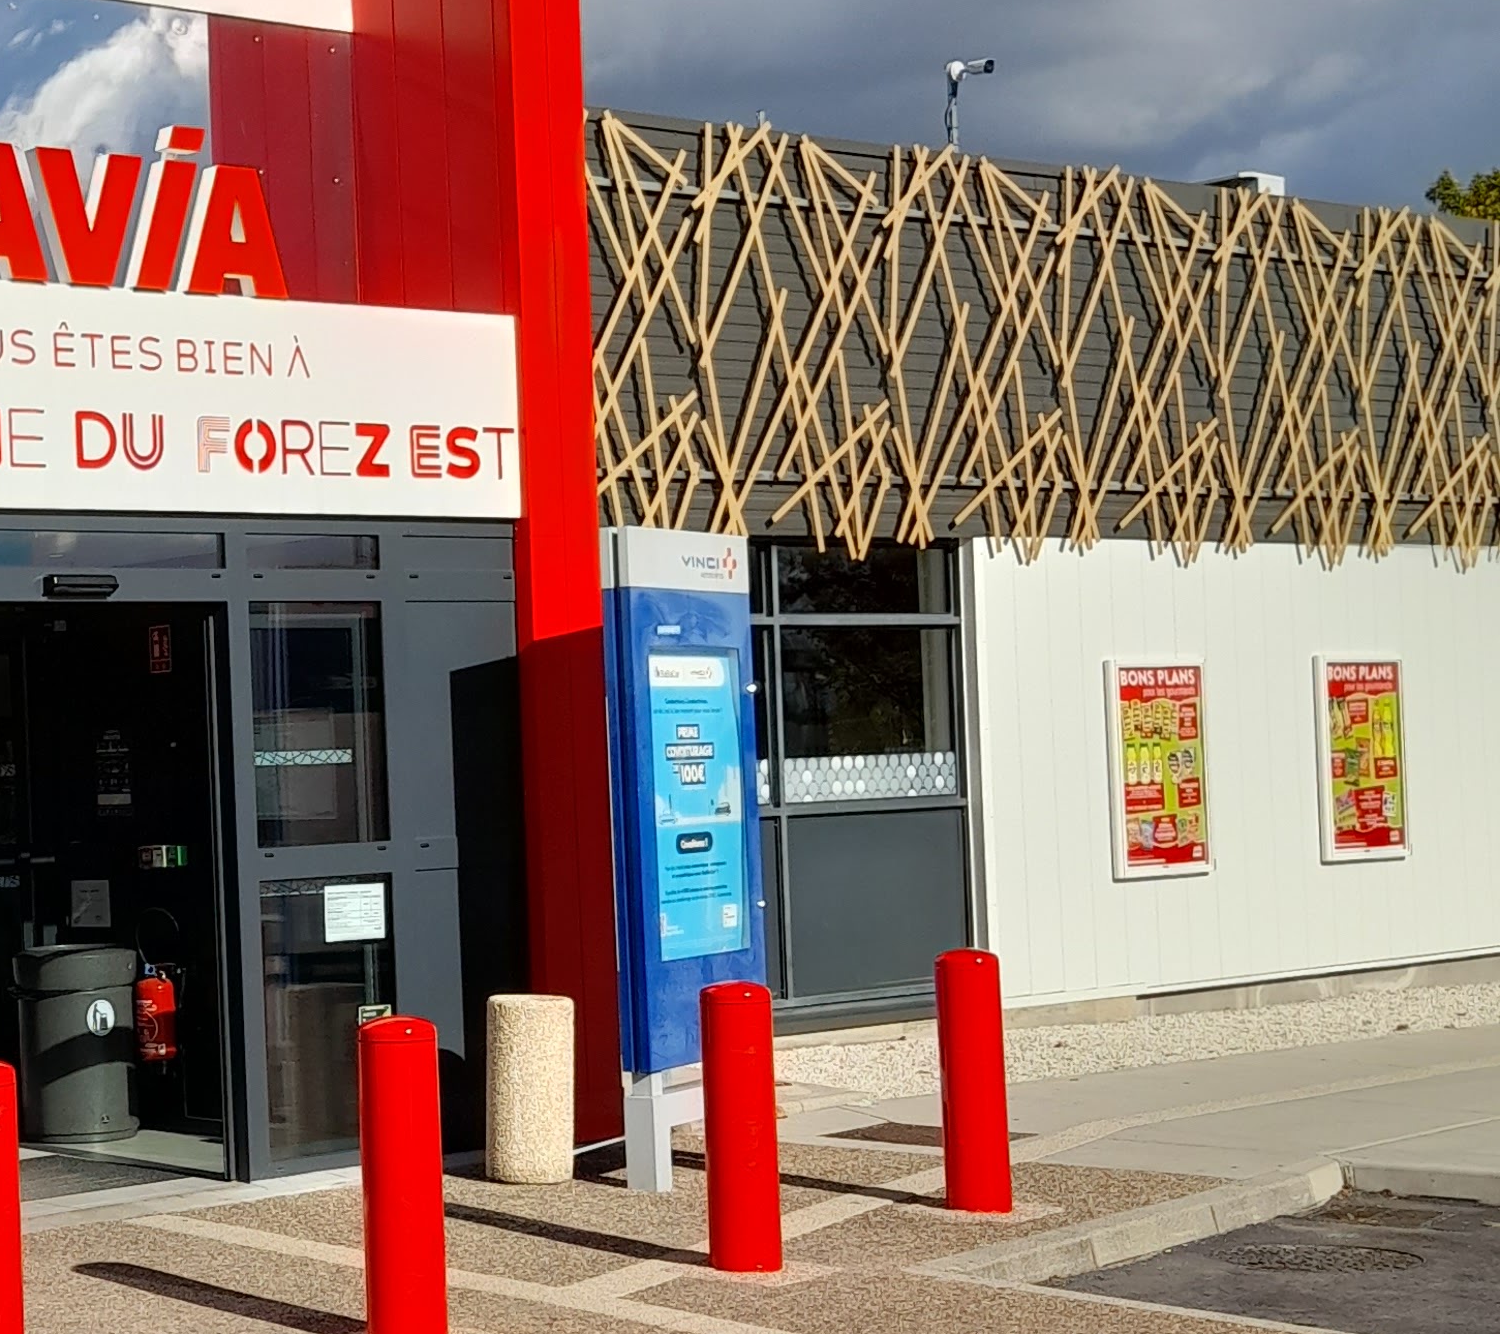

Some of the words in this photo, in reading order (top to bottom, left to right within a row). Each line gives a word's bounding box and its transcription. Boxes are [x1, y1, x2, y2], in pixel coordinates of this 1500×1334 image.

[52, 322, 162, 371] ÊTES
[176, 338, 272, 376] BIEN
[287, 335, 311, 378] À
[75, 410, 163, 470] DU
[196, 415, 391, 478] FOREZ
[409, 424, 515, 480] EST
[681, 555, 720, 569] VINCI
[1120, 670, 1155, 686] BONS
[1157, 669, 1195, 685] PLANS
[1327, 665, 1357, 681] BONS
[1359, 665, 1393, 681] PLANS
